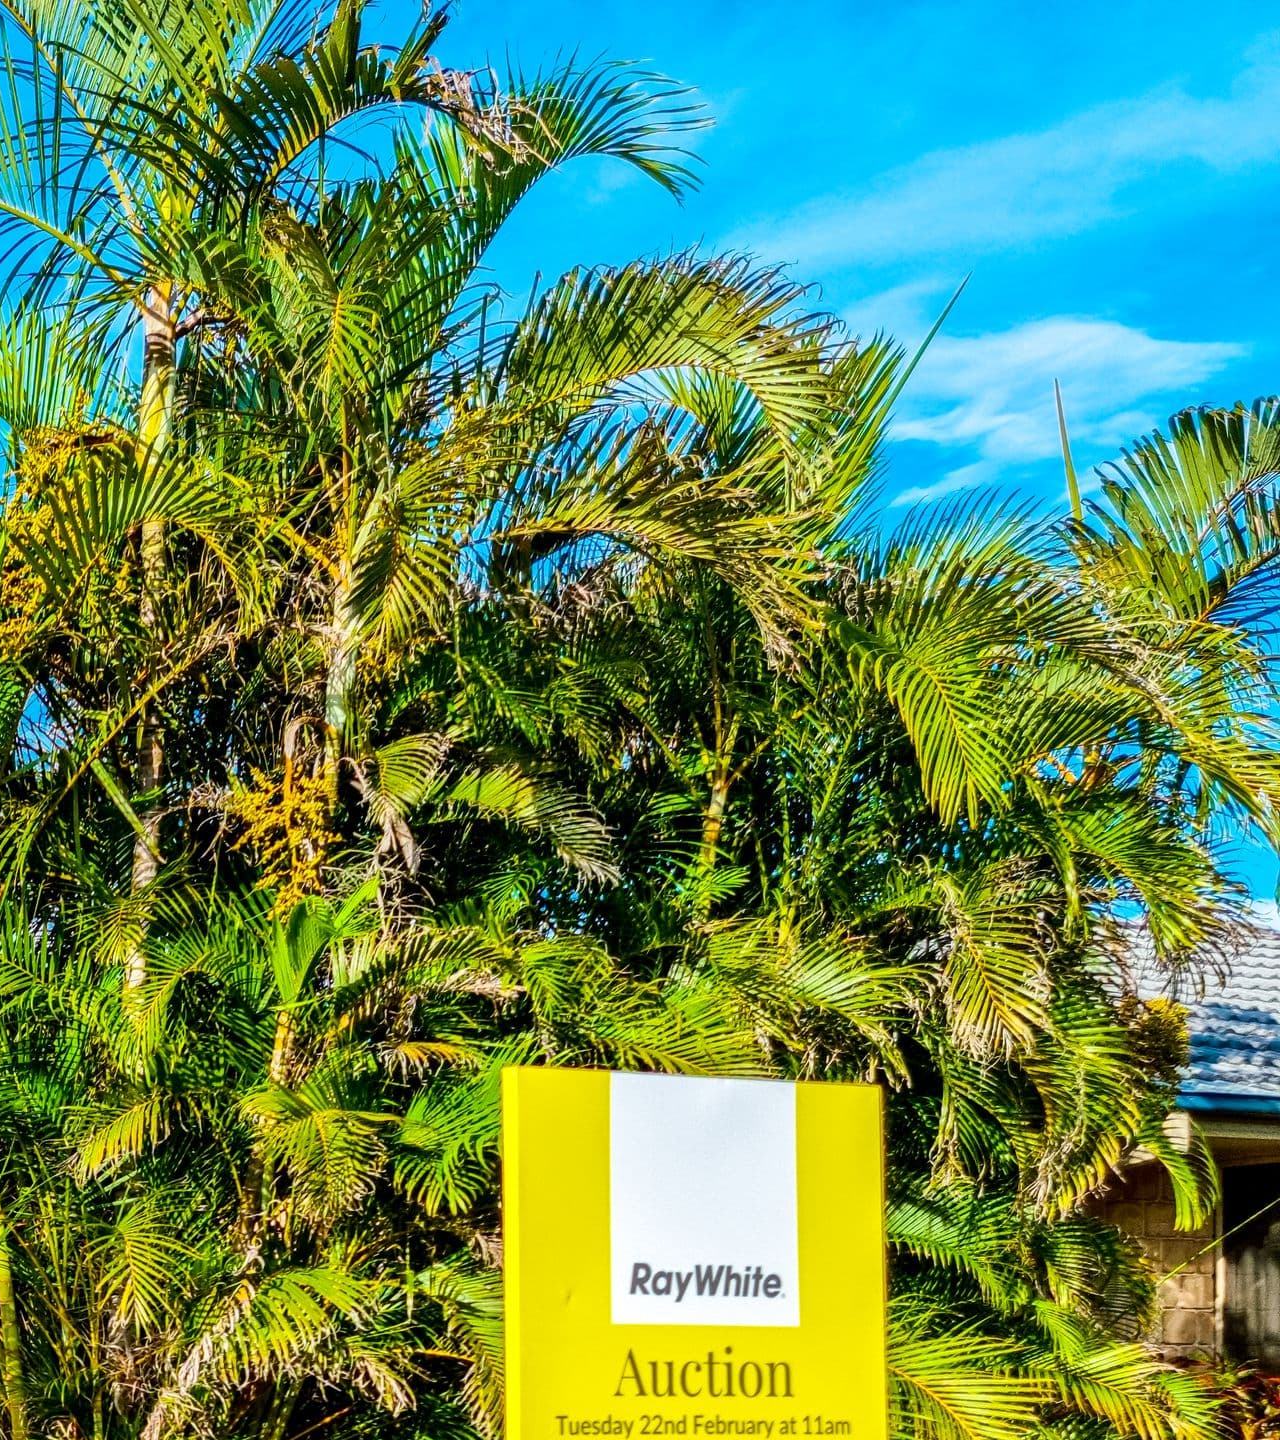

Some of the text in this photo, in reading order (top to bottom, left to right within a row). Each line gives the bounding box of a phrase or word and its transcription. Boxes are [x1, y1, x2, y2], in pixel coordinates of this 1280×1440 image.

[613, 1345, 794, 1398] Auction
[556, 1415, 851, 1439] Tuesday 22nd February at 11am
